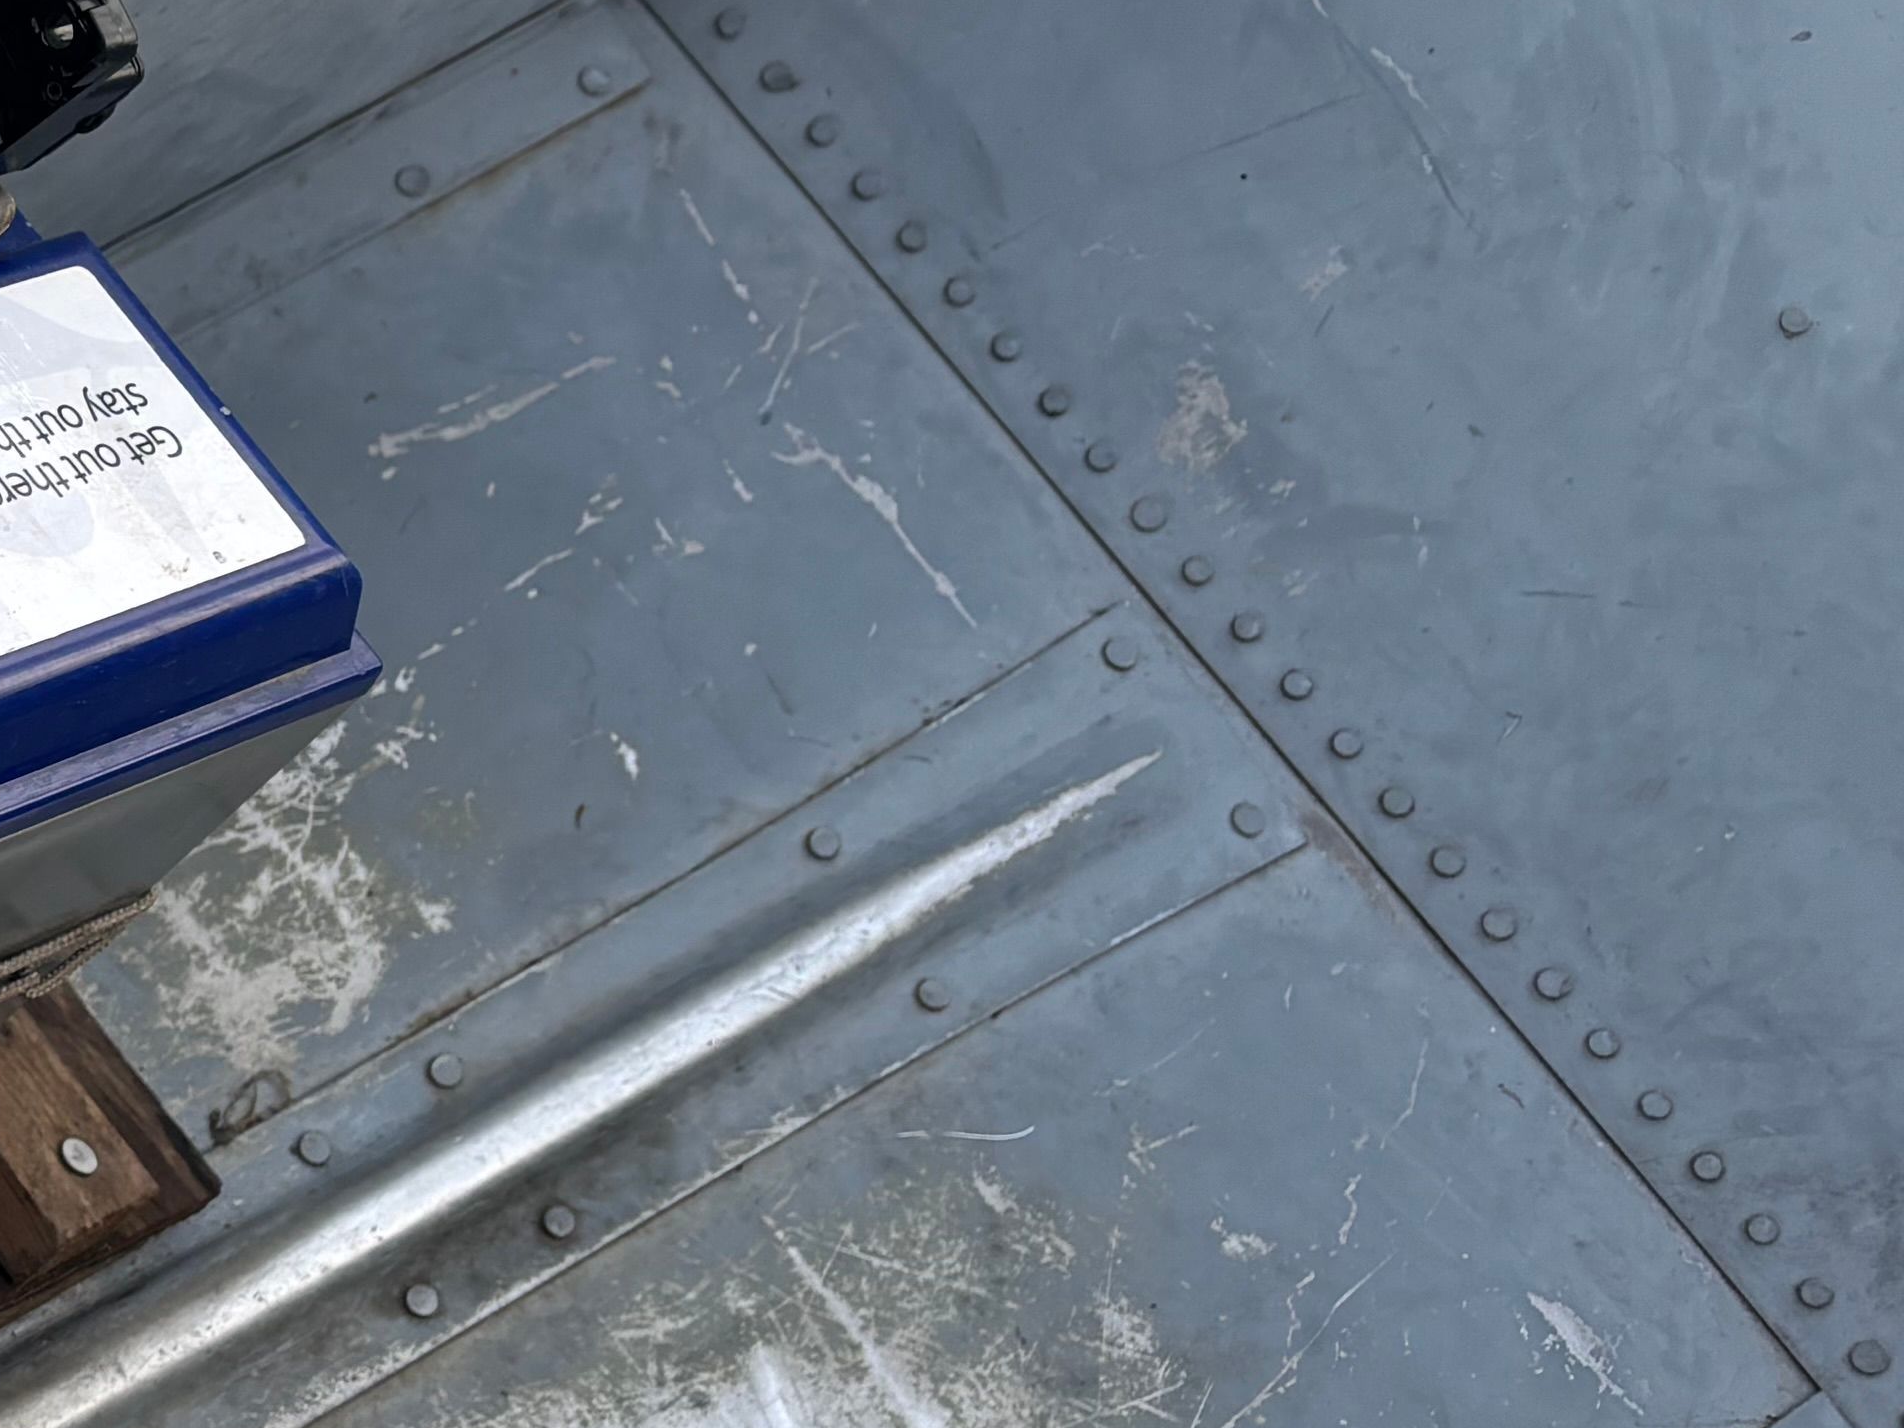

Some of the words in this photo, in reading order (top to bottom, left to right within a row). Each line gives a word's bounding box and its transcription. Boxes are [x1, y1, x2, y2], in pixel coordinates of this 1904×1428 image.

[82, 382, 149, 422] stay
[22, 404, 83, 445] out
[60, 443, 121, 484] out
[116, 425, 183, 465] Get
